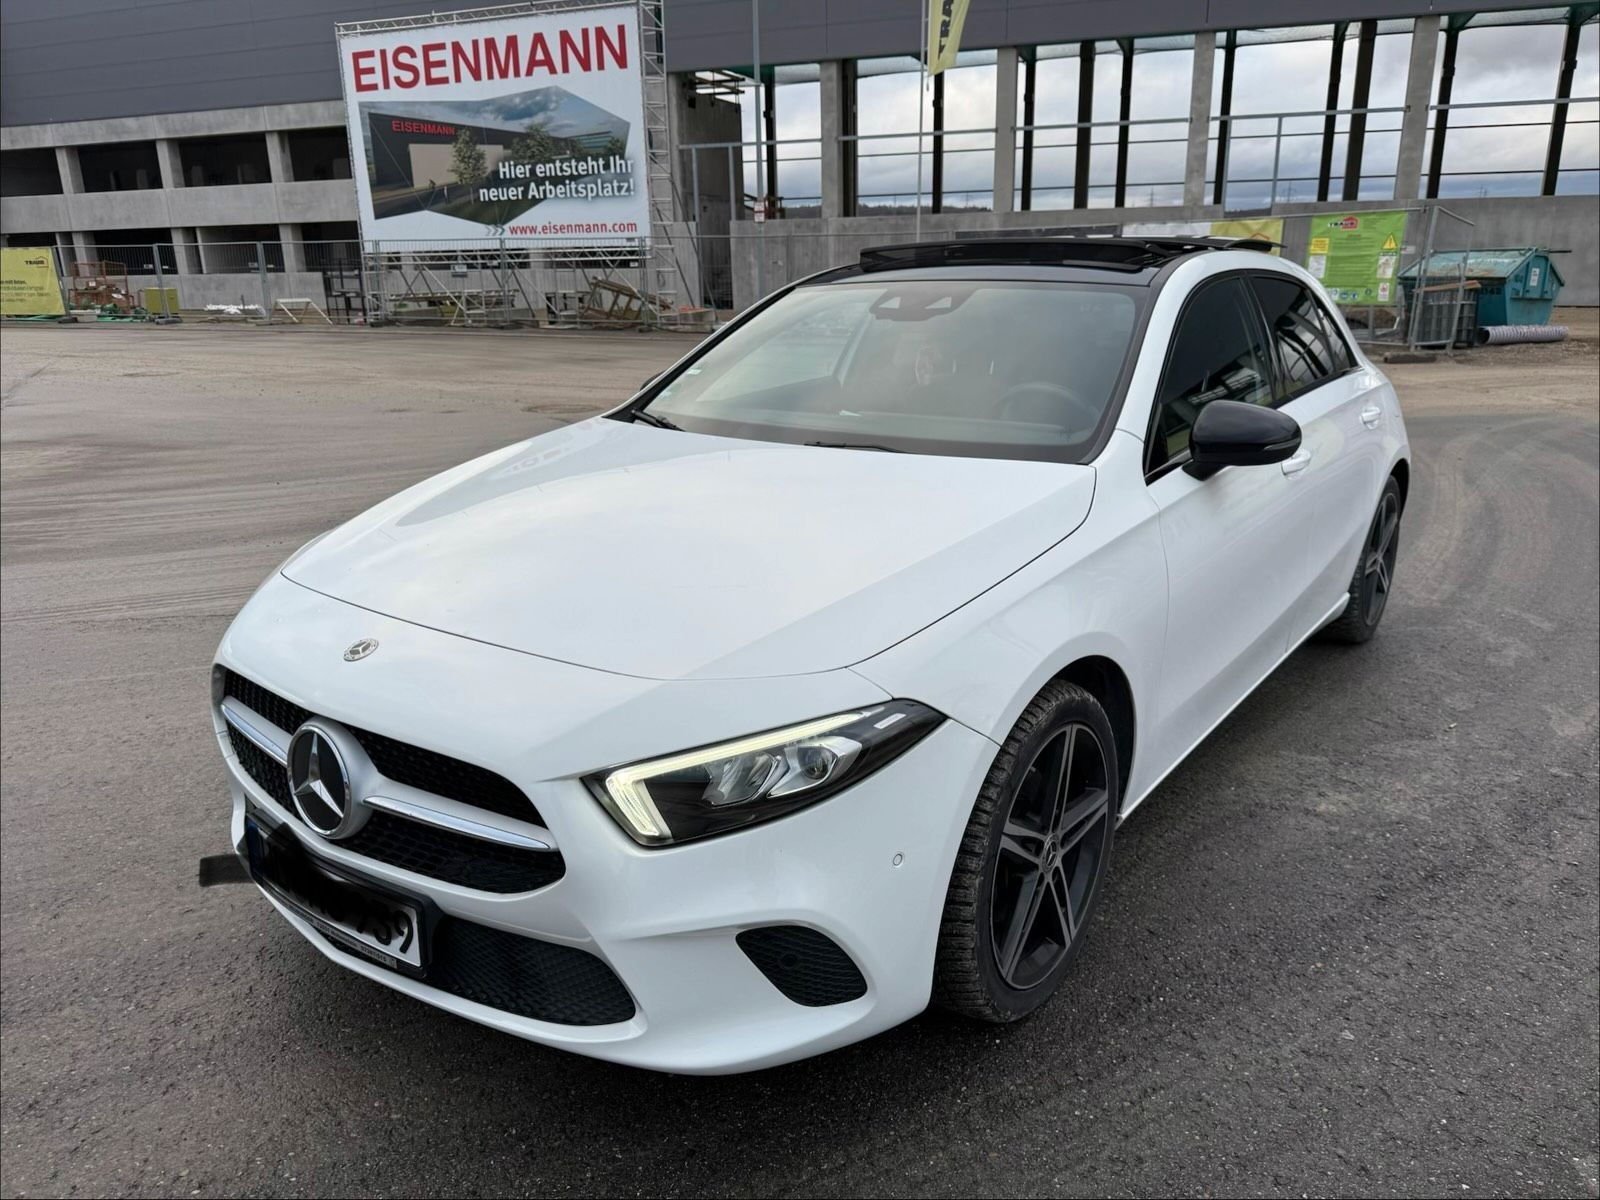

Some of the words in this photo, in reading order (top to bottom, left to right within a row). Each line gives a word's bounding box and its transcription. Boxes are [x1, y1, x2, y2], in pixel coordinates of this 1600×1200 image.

[351, 24, 629, 93] EISENMANN
[391, 120, 456, 136] EISENMANN
[499, 160, 531, 179] Hier
[535, 156, 605, 177] entsteht
[610, 155, 633, 173] Ihr
[479, 186, 524, 201] neuer
[528, 180, 634, 200] Arbeitsplatz!
[508, 221, 637, 235] www.eisenmann.com
